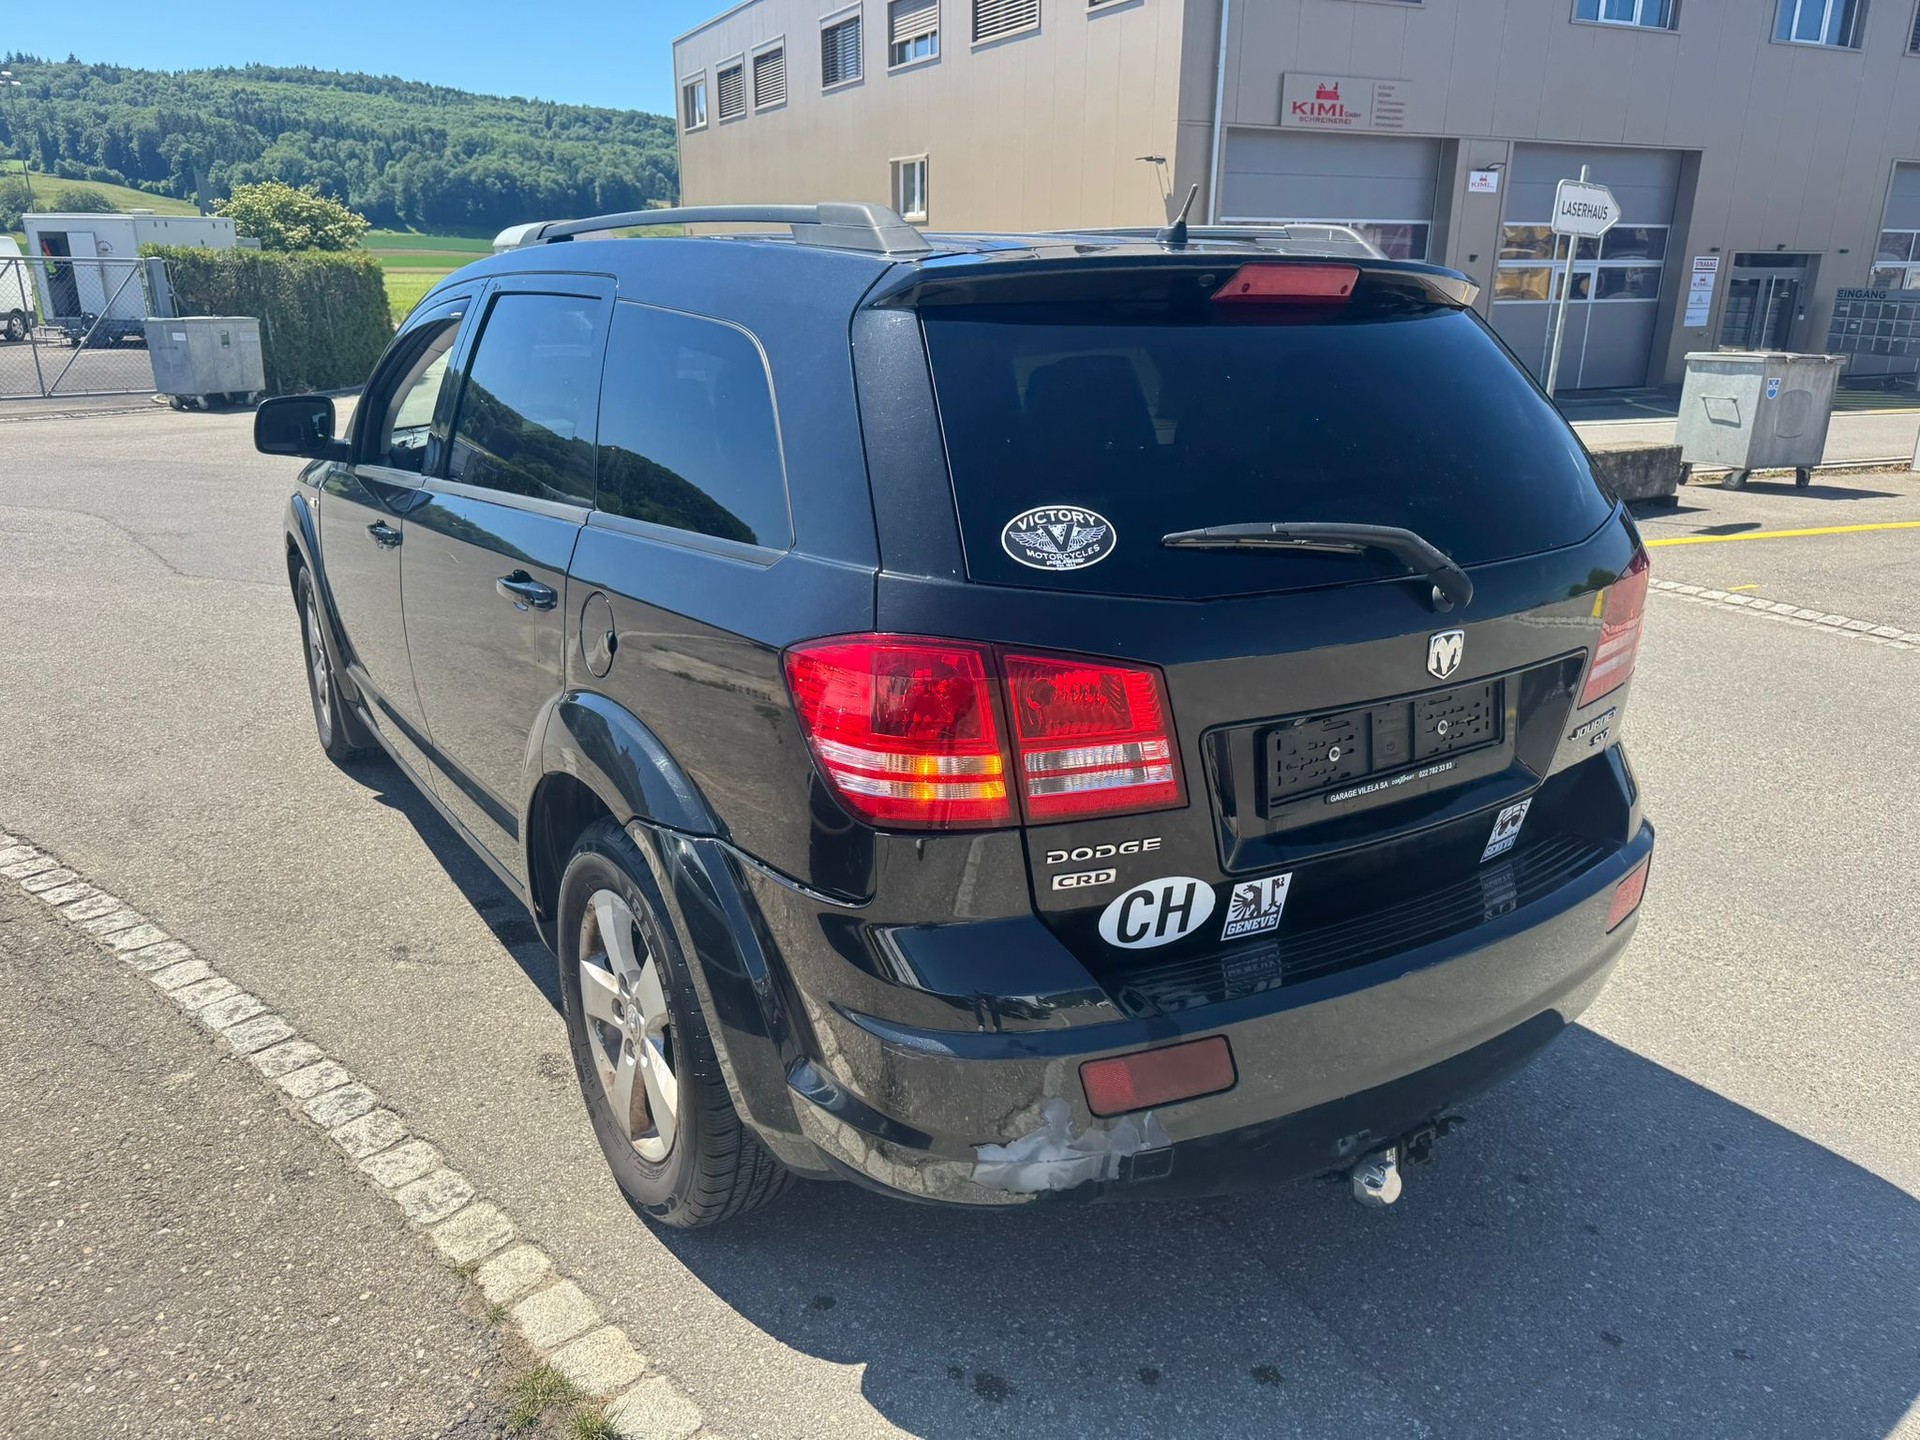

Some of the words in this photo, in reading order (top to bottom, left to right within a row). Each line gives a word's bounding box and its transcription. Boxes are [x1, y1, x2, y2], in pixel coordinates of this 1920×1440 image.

[1291, 101, 1344, 117] KIMI
[1299, 116, 1352, 125] SCHREINEREI
[1561, 200, 1609, 220] LASERHAUS
[1837, 289, 1888, 299] EINGANG
[1017, 510, 1096, 531] VICTORY
[1026, 544, 1101, 560] MOTORCYCLES
[1330, 789, 1358, 803] GARAGE
[1357, 782, 1380, 795] VILELA
[1379, 780, 1389, 789] SA
[1418, 769, 1429, 778] 022
[1046, 837, 1162, 865] DODGE
[1057, 871, 1113, 888] CRD
[1116, 882, 1197, 944] CH
[1226, 913, 1278, 936] GENEVE
